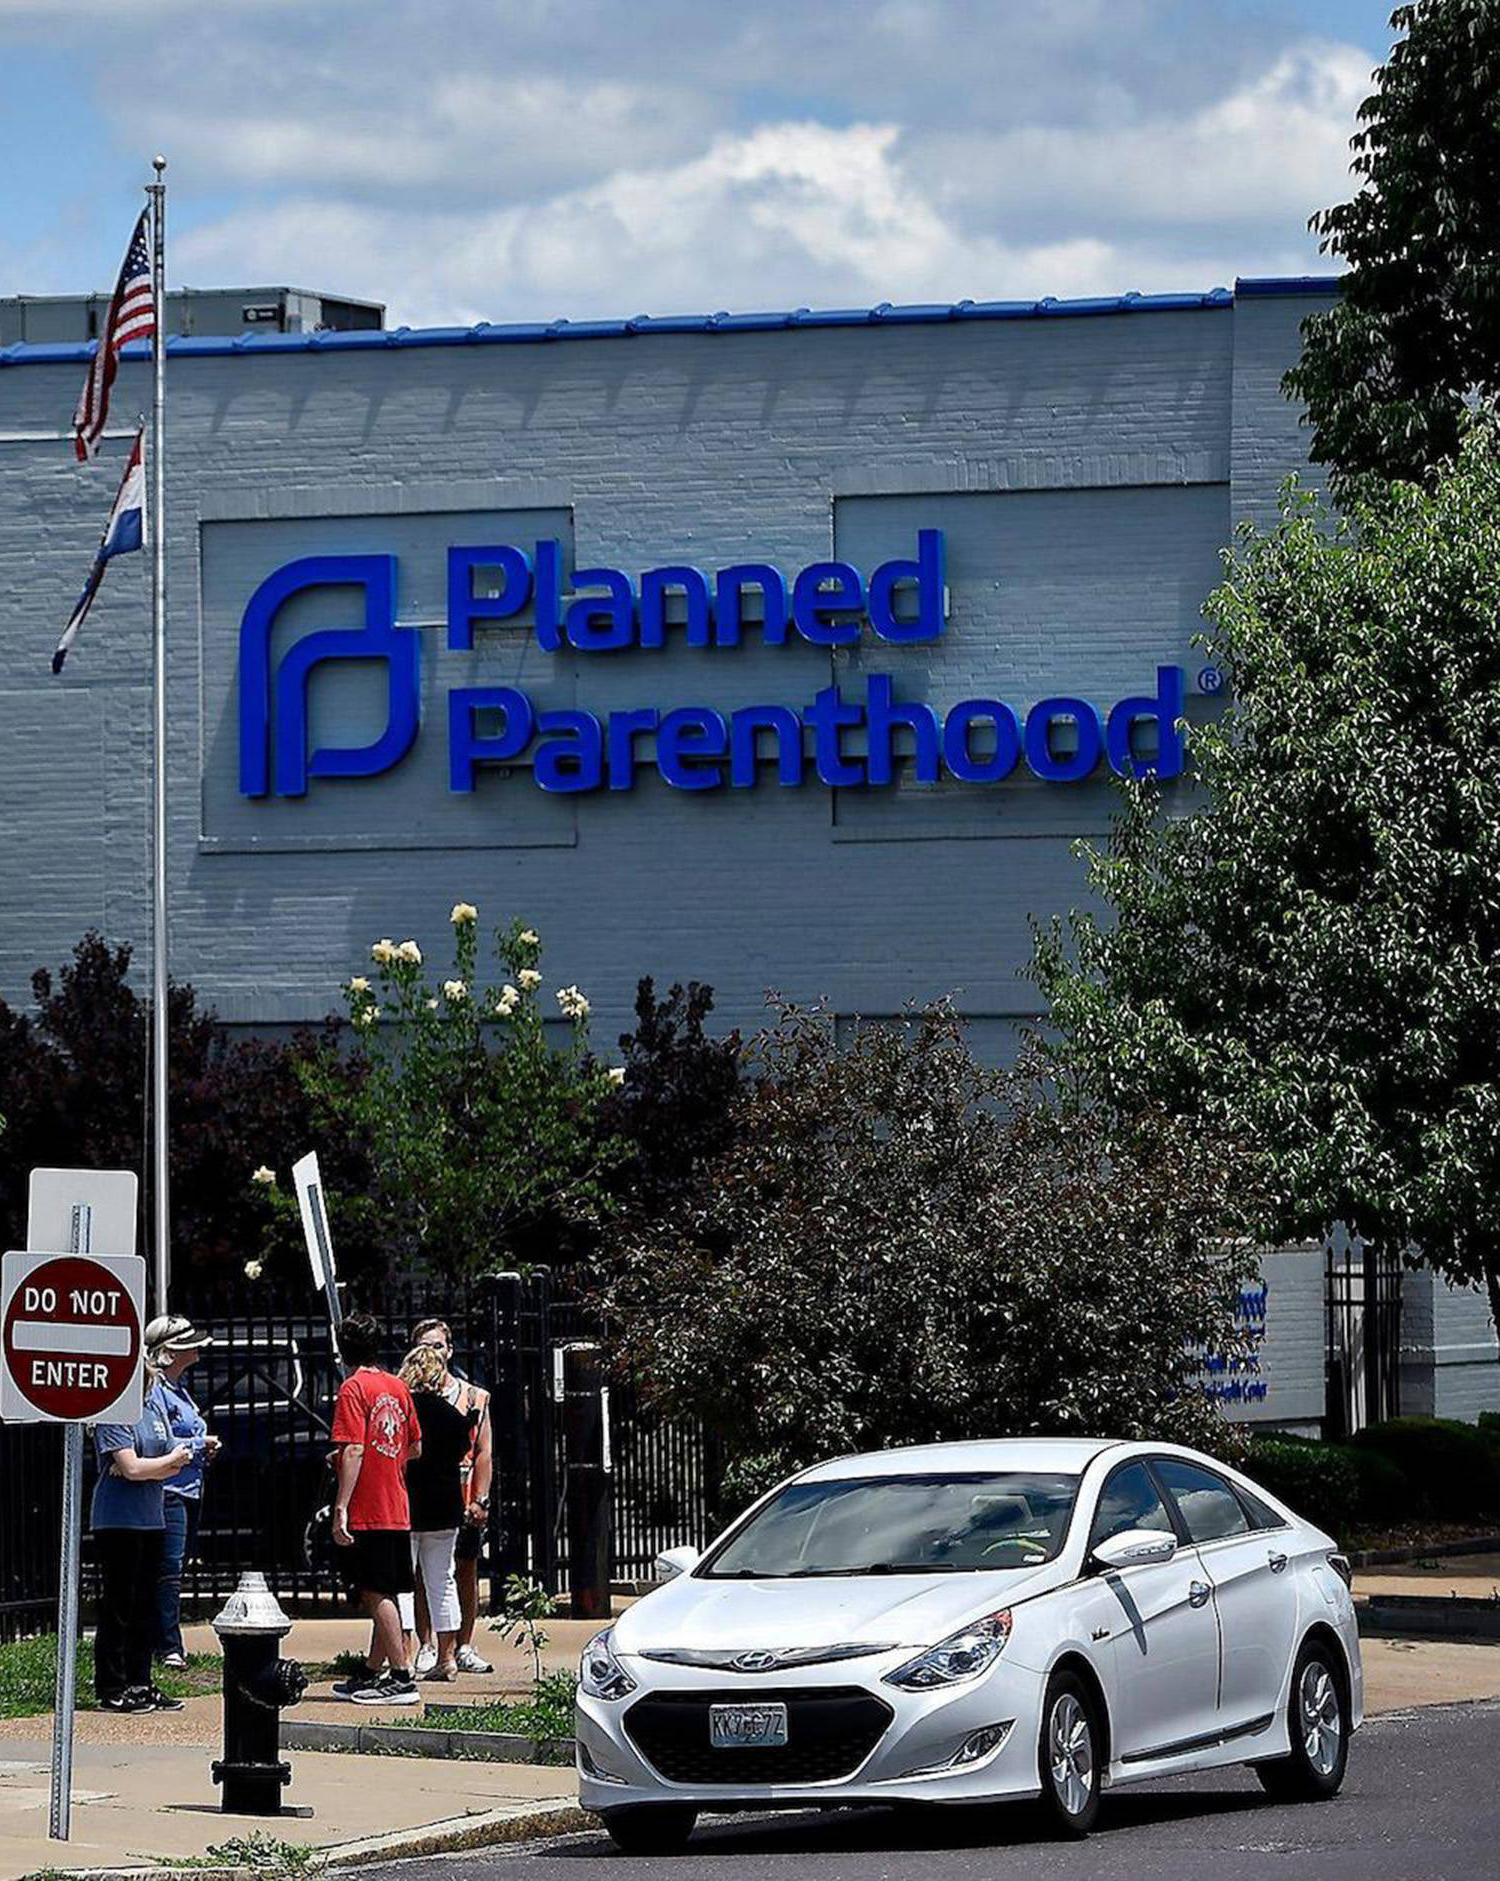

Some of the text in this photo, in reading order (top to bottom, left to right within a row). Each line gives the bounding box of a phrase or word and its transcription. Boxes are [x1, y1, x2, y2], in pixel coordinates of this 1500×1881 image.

[447, 529, 945, 653] Planned
[447, 665, 1184, 794] Parenthood
[25, 1287, 121, 1315] DO NOT
[31, 1360, 108, 1388] ENTER
